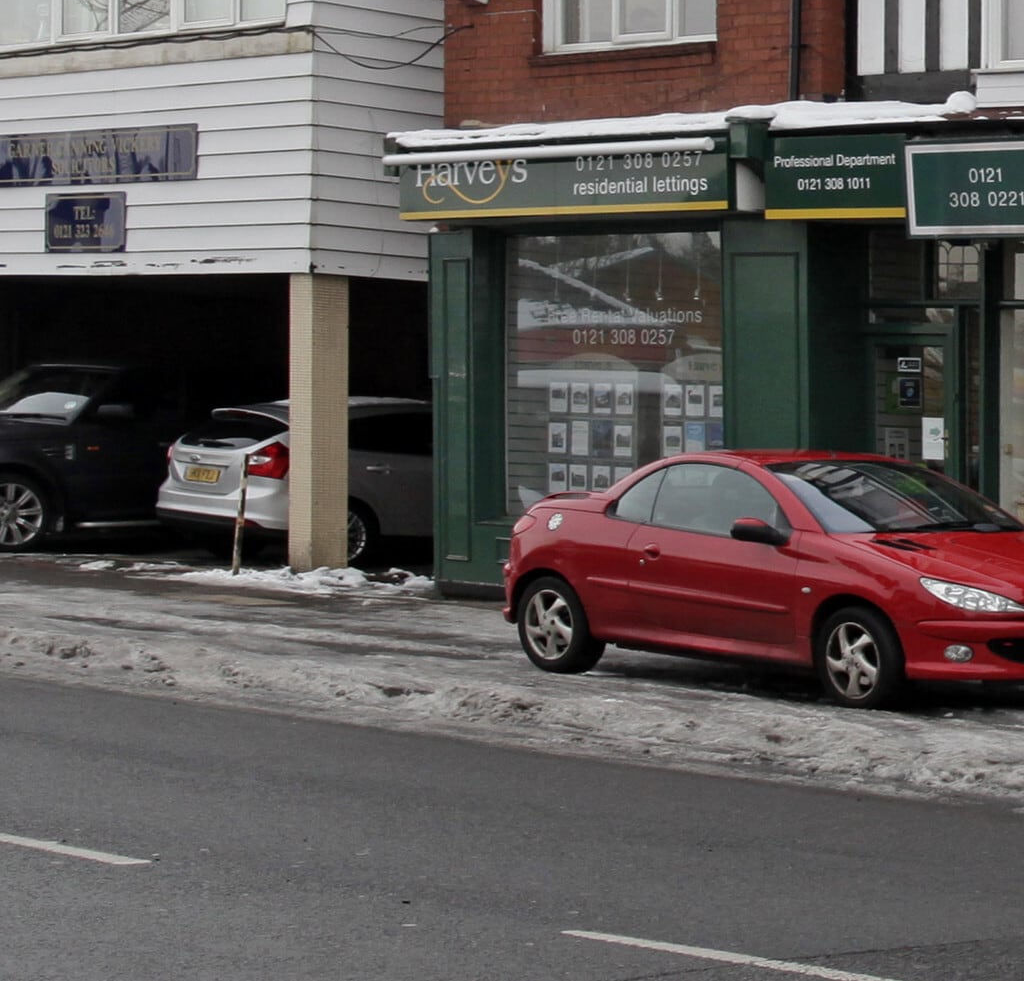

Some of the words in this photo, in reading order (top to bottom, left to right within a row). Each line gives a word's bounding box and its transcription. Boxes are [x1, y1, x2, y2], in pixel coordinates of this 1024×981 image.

[774, 155, 834, 168] Professional
[836, 153, 896, 168] Department
[416, 158, 528, 204] Harveys
[575, 155, 614, 171] 0121
[623, 153, 654, 169] 308
[661, 151, 702, 168] 0257
[968, 168, 1003, 183] 0121
[573, 177, 648, 195] residential
[653, 175, 708, 195] lettings
[797, 178, 822, 191] 0121
[824, 177, 844, 190] 308
[847, 177, 871, 190] 1011
[949, 192, 980, 208] 308
[73, 206, 95, 220] TEL:
[54, 224, 72, 238] 0121
[74, 223, 90, 238] 323
[630, 308, 703, 324] Valuations
[572, 329, 605, 345] 0121
[610, 329, 637, 345] 308
[640, 329, 676, 345] 0257
